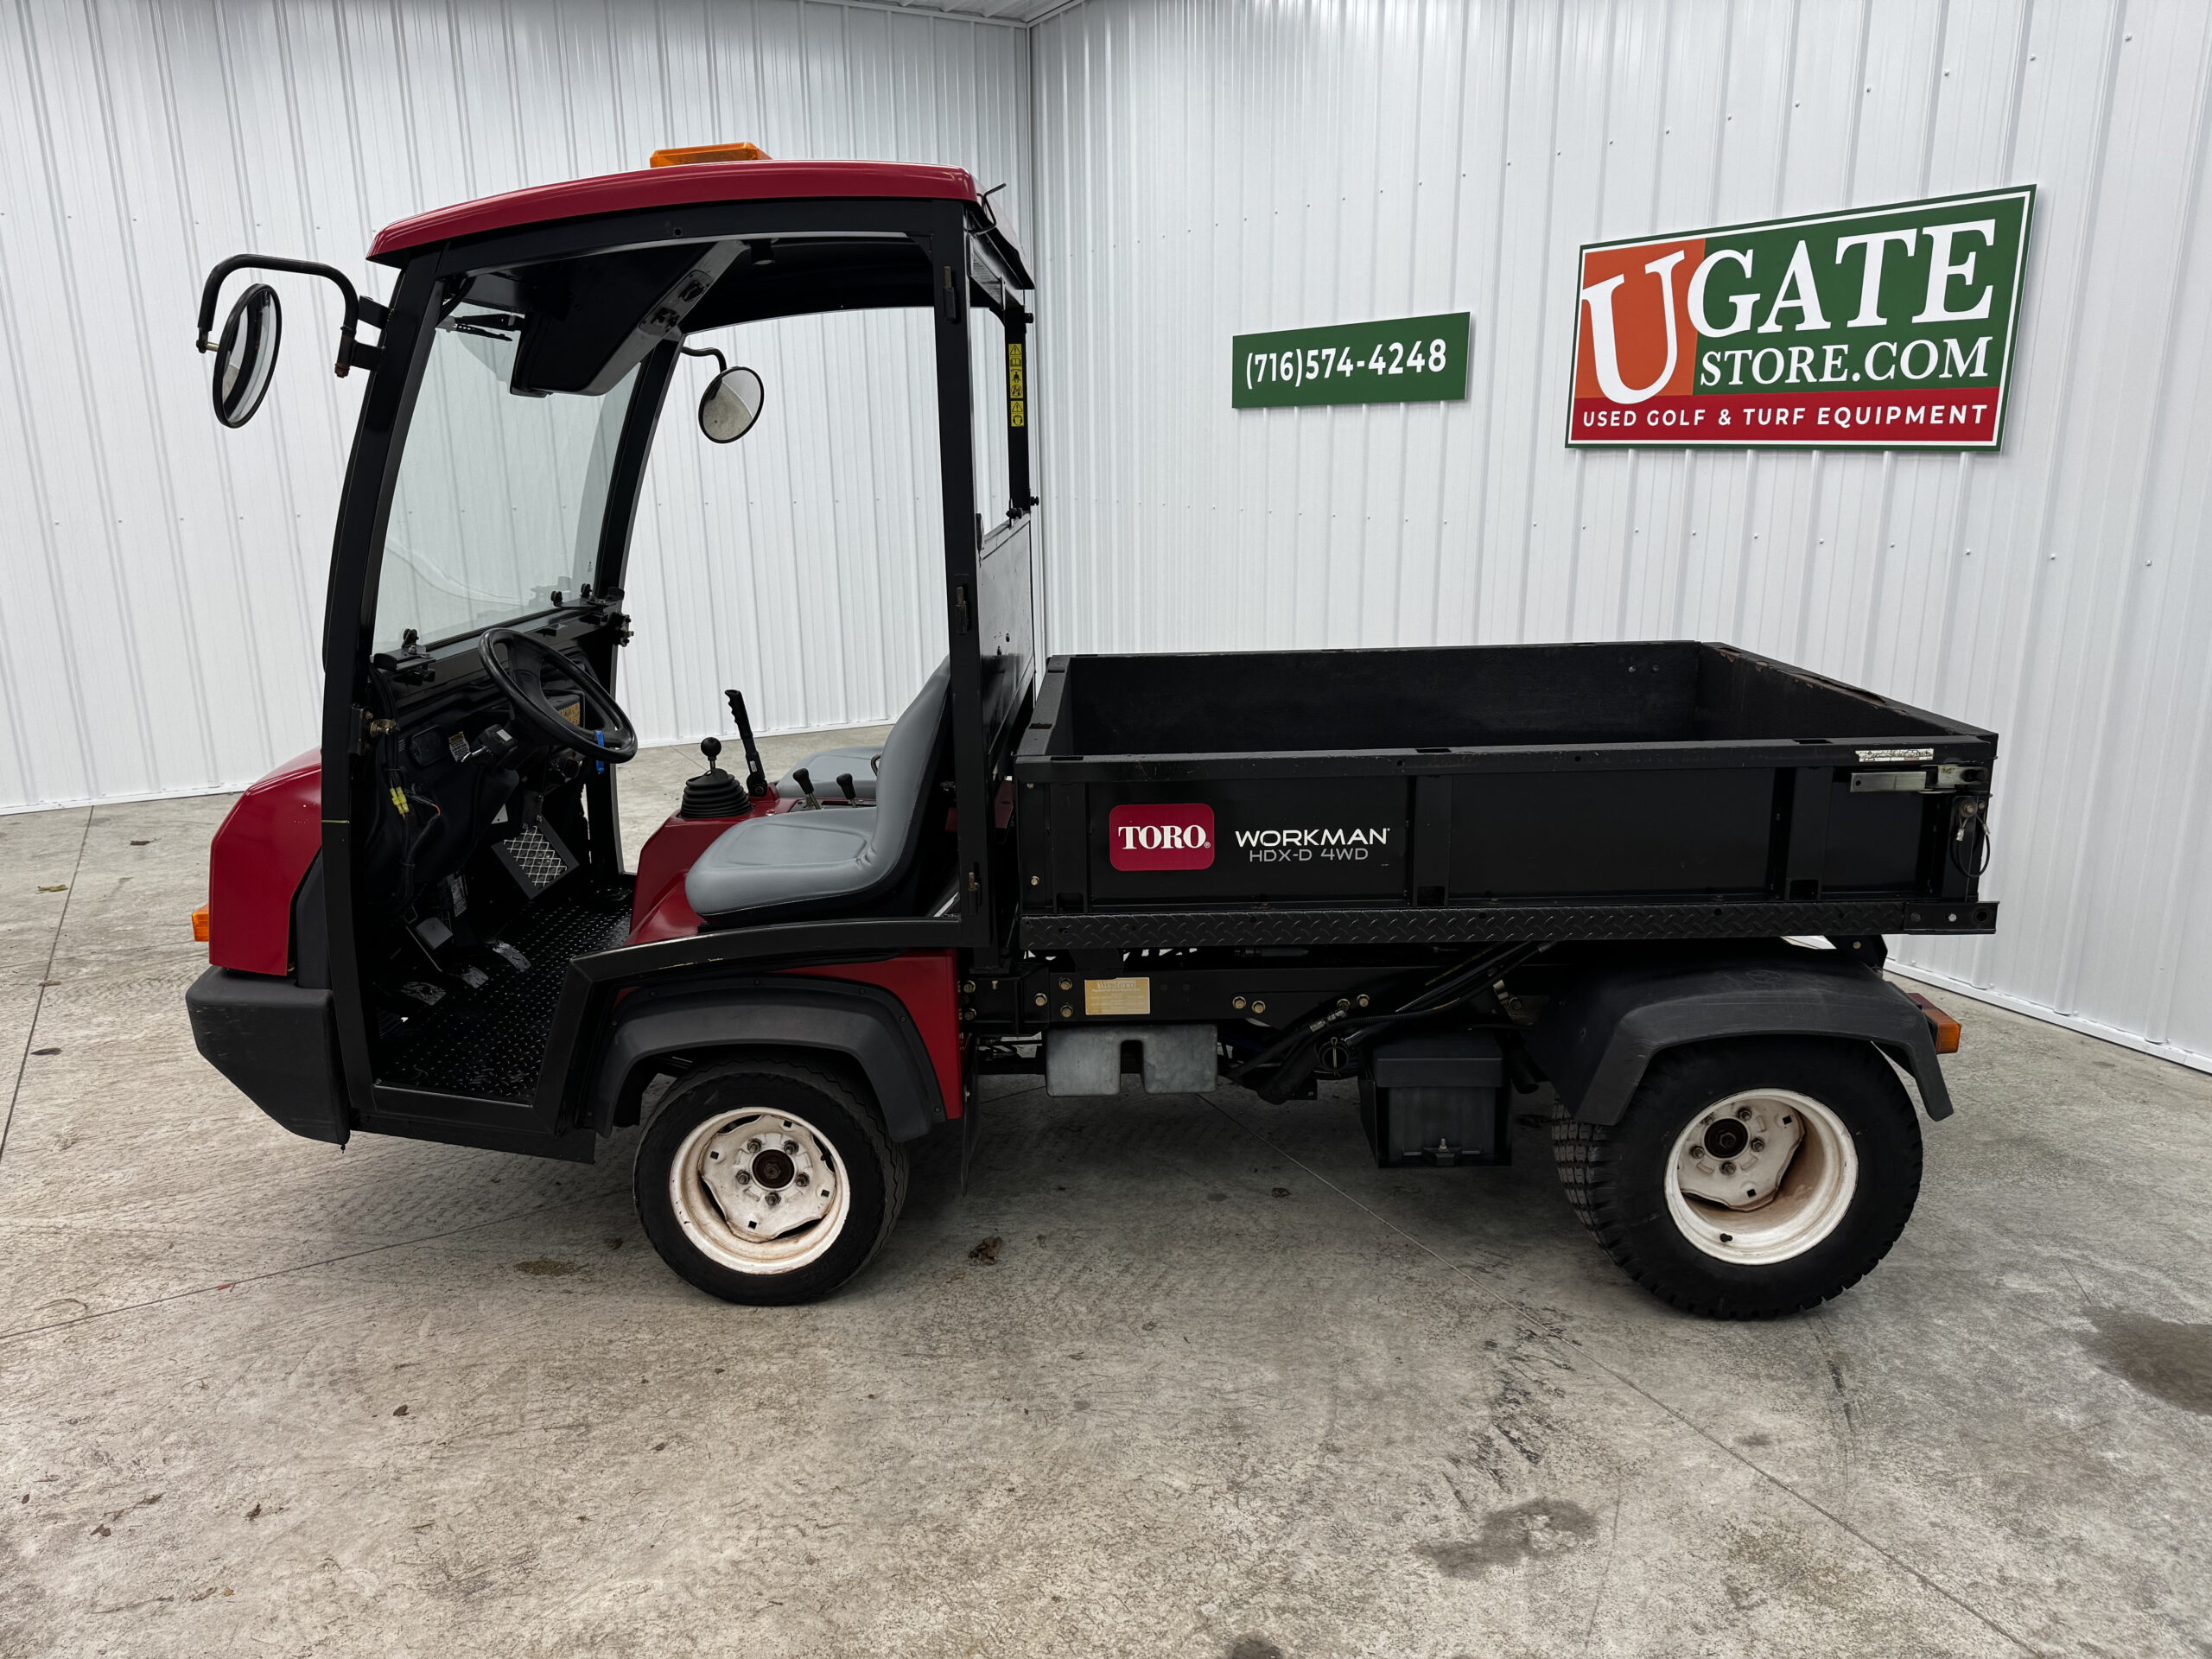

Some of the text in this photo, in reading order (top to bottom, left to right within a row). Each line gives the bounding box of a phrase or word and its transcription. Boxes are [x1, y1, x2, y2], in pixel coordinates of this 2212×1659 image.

[1581, 219, 1997, 404] UGATE
[1246, 338, 1447, 390] (716)574-4248
[1699, 336, 1994, 388] STORE.COM
[1582, 404, 1989, 429] USED GOLF & TURF EQUIPMENT
[1118, 824, 1207, 849] TORO
[1235, 828, 1388, 848] WORKMAN
[1249, 848, 1369, 862] HDX-D 4WD
